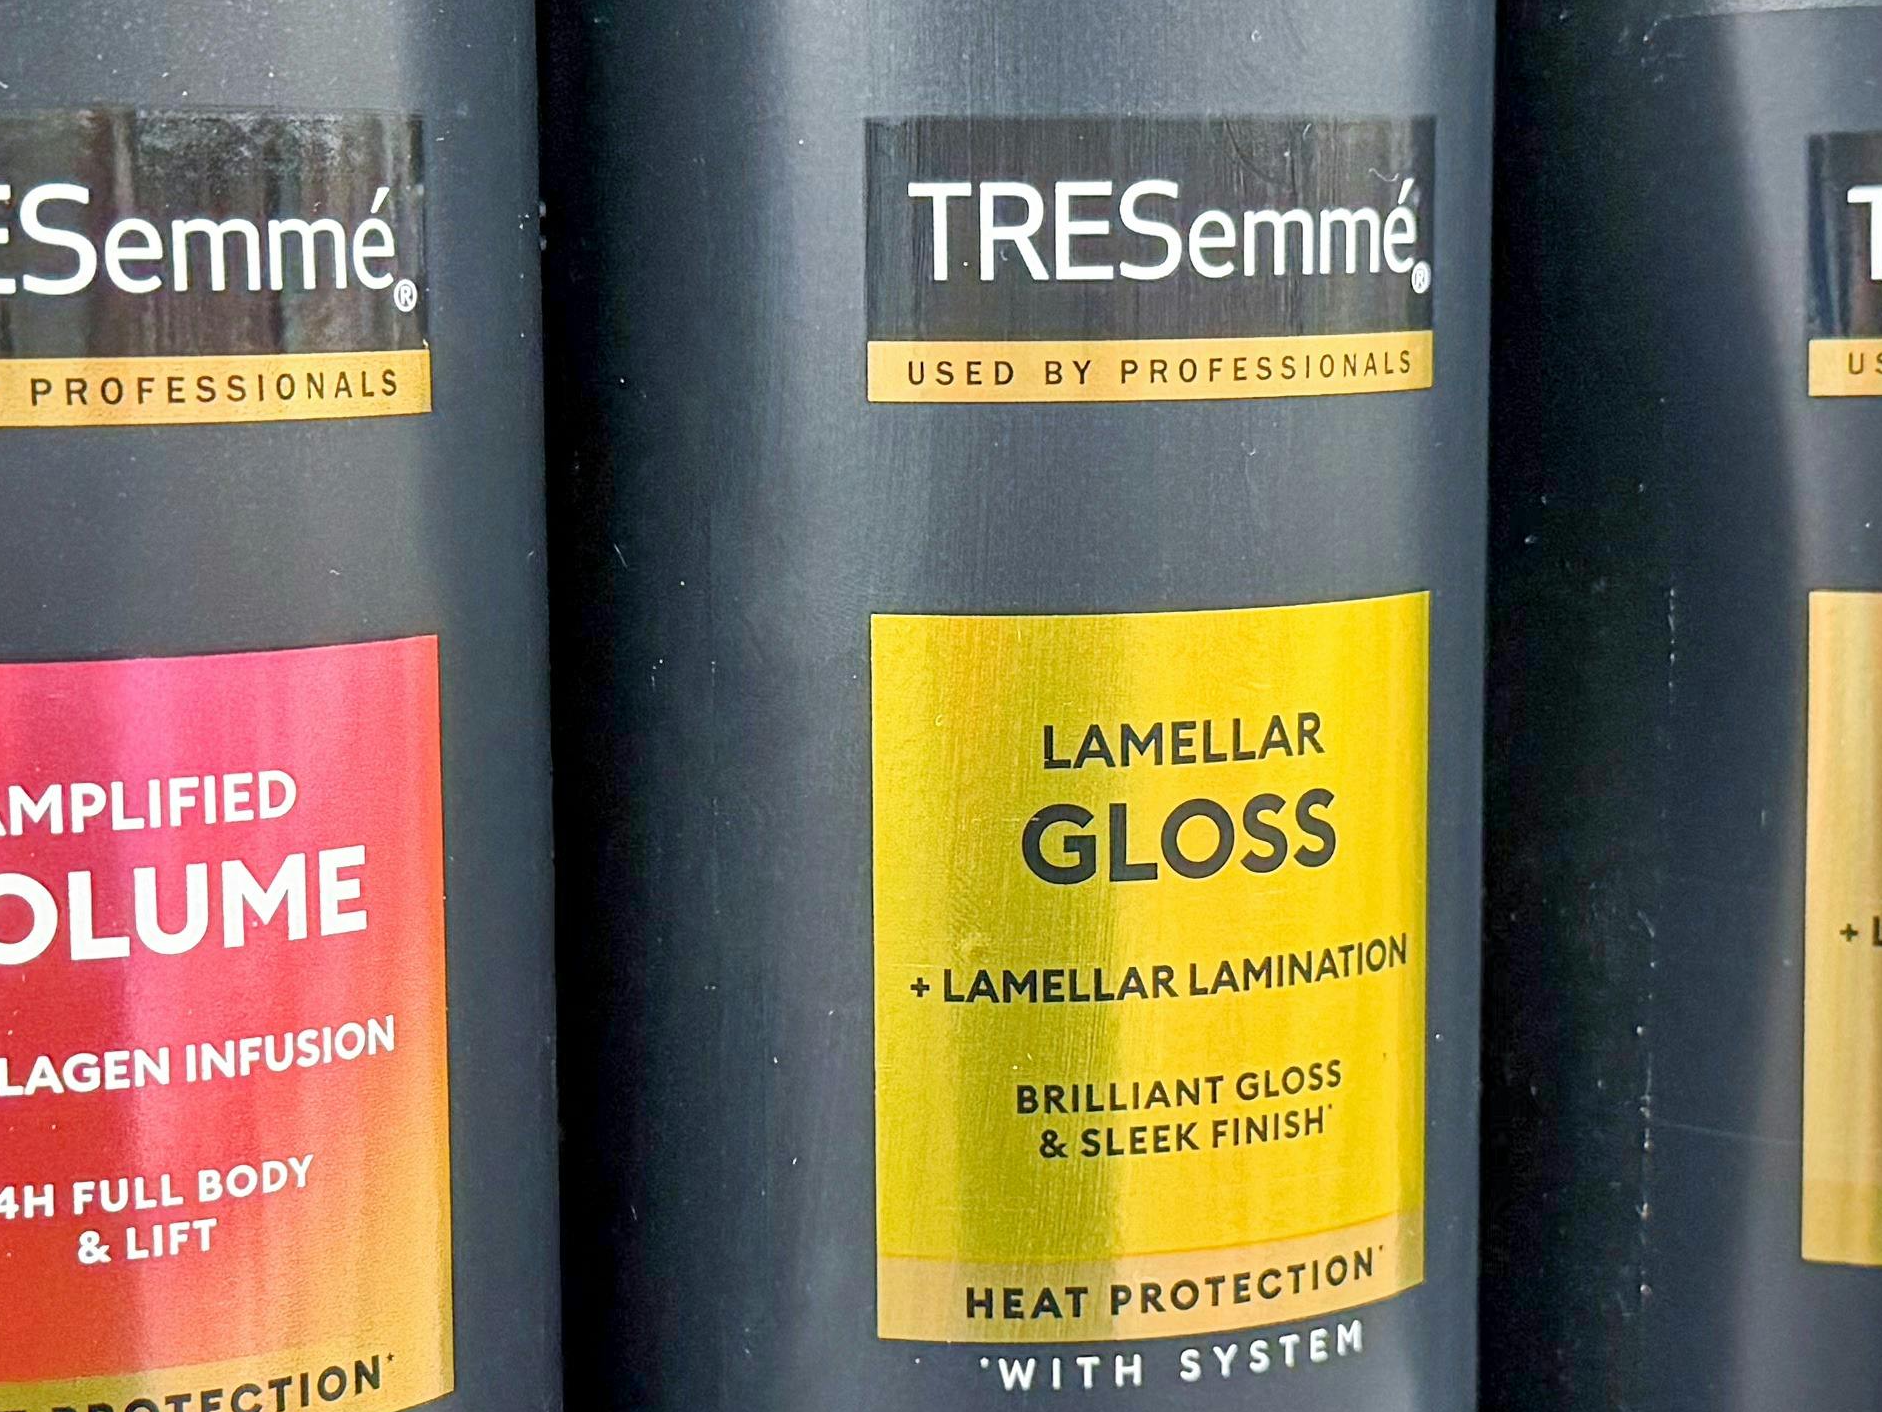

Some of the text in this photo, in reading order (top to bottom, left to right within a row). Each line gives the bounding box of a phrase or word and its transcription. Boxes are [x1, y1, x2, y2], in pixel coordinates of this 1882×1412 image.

[31, 369, 399, 406] PROFESSIONALS
[907, 350, 1412, 385] USED BY PROFESSIONALS
[1043, 711, 1325, 770] LAMELLAR
[1021, 788, 1336, 885] GLOSS
[943, 933, 1408, 1003] LAMELLAR LAMINATION
[186, 1015, 396, 1082] INFUSION
[1016, 1059, 1342, 1115] BRILLIANT GLOSS
[1039, 1129, 1068, 1159] &
[1081, 1122, 1200, 1157] SLEEK
[73, 1173, 184, 1214] FULL
[198, 1154, 315, 1200] BODY
[77, 1218, 217, 1264] & LIFT
[966, 1287, 1089, 1319] HEAT
[1179, 1319, 1364, 1381] SYSTEM
